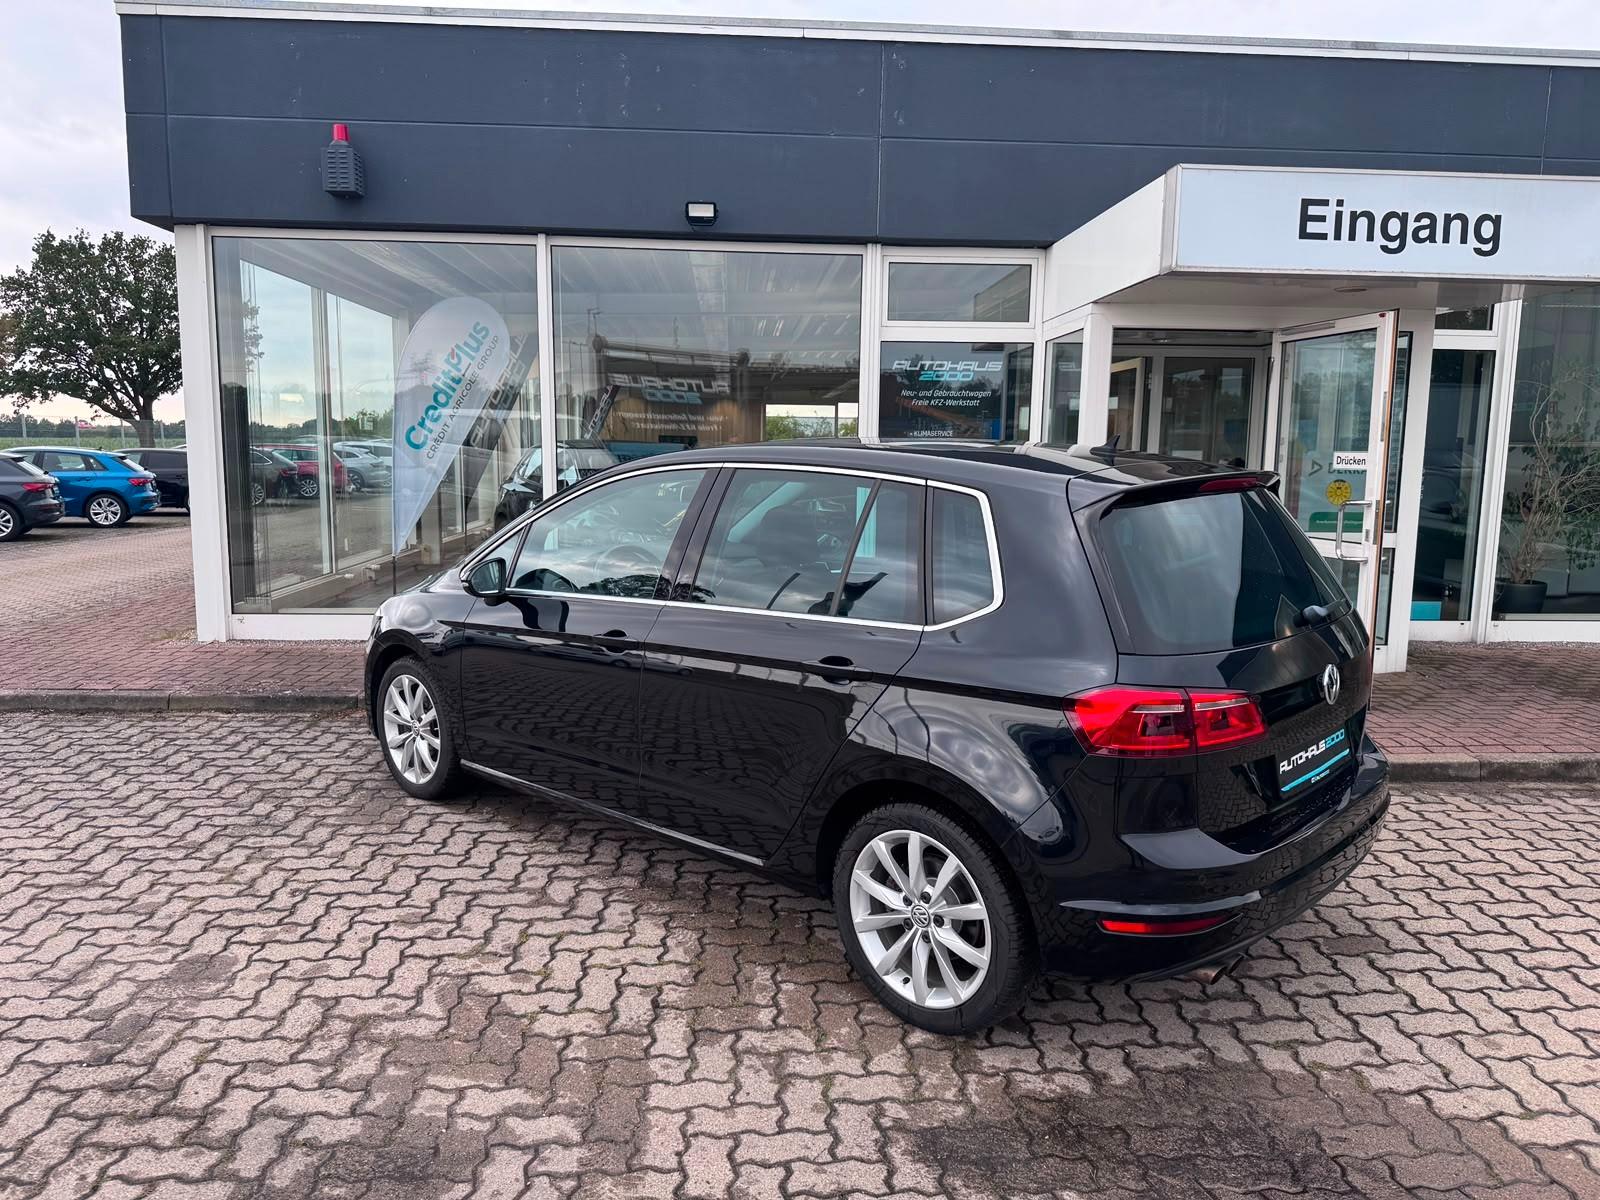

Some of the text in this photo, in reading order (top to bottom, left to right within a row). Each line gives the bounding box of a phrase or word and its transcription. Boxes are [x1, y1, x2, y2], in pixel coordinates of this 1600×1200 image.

[1298, 197, 1503, 258] Eingang
[893, 361, 1003, 371] AUTOHAUS
[450, 371, 480, 423] AGRICOLE
[476, 334, 500, 371] GROUP
[919, 372, 974, 381] 2000
[404, 320, 491, 451] CreditPlus
[900, 389, 991, 398] Neu- und Gebrauchtwagen
[911, 398, 981, 407] Freie KFZ-Werkstatt
[1336, 455, 1366, 466] Drücken
